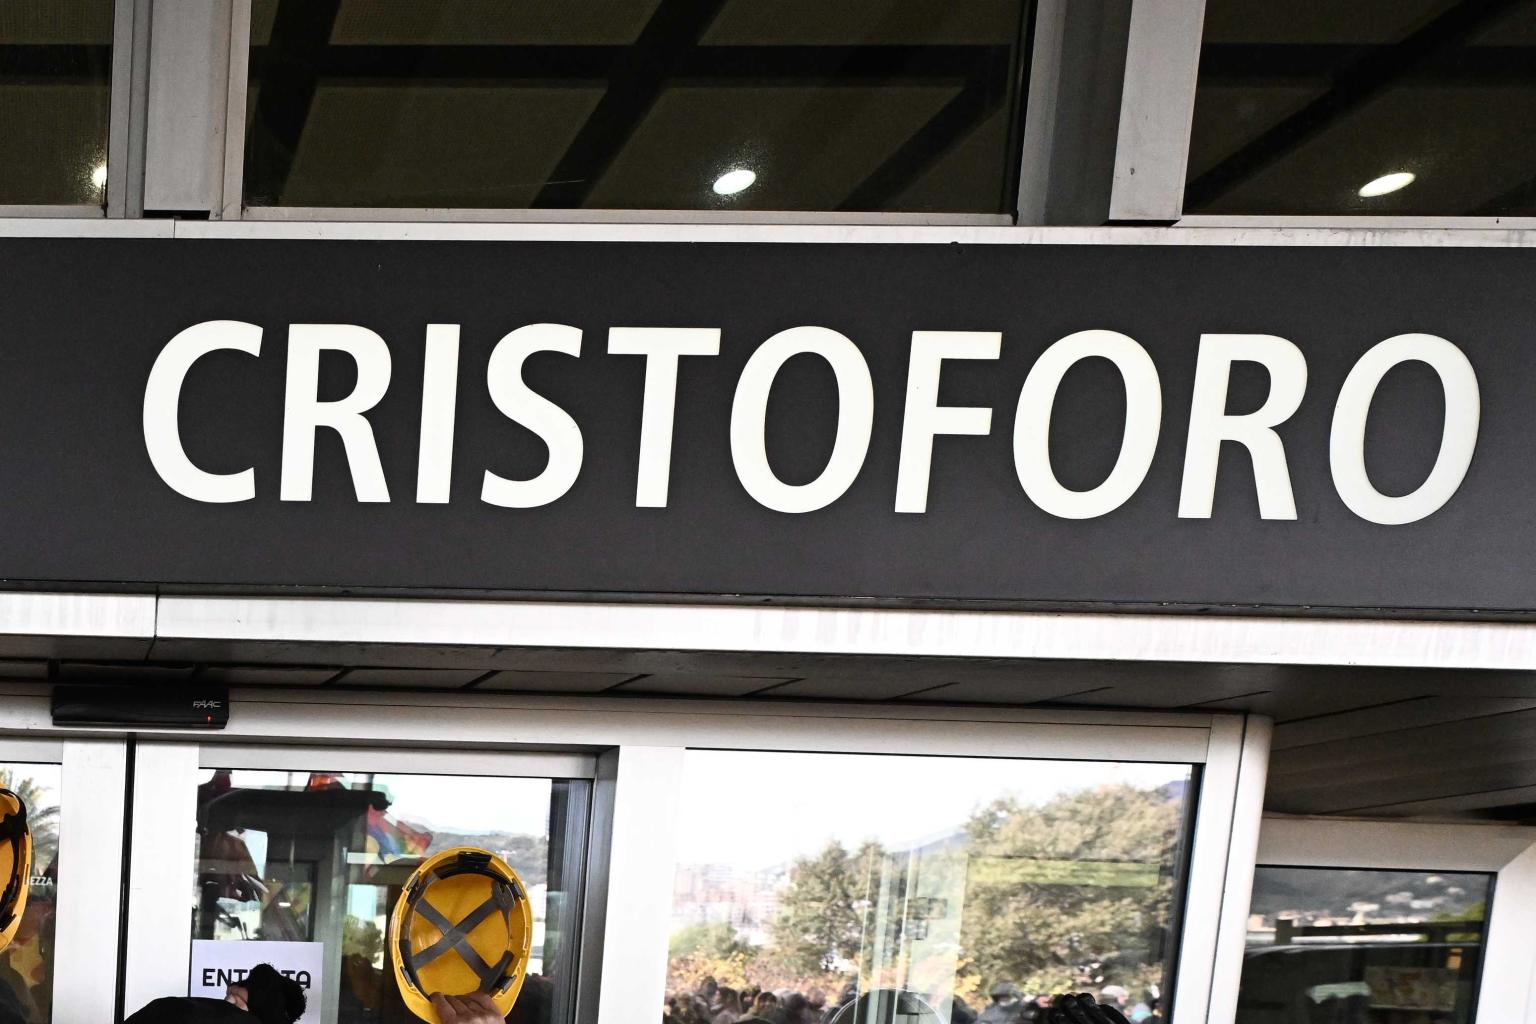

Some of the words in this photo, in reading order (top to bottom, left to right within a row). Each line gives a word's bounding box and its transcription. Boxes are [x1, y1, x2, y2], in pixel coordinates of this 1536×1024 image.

[143, 320, 1480, 525] CRISTOFORO
[193, 700, 222, 708] FAAC
[30, 876, 53, 886] EZZA
[202, 968, 311, 989] ENTTA
